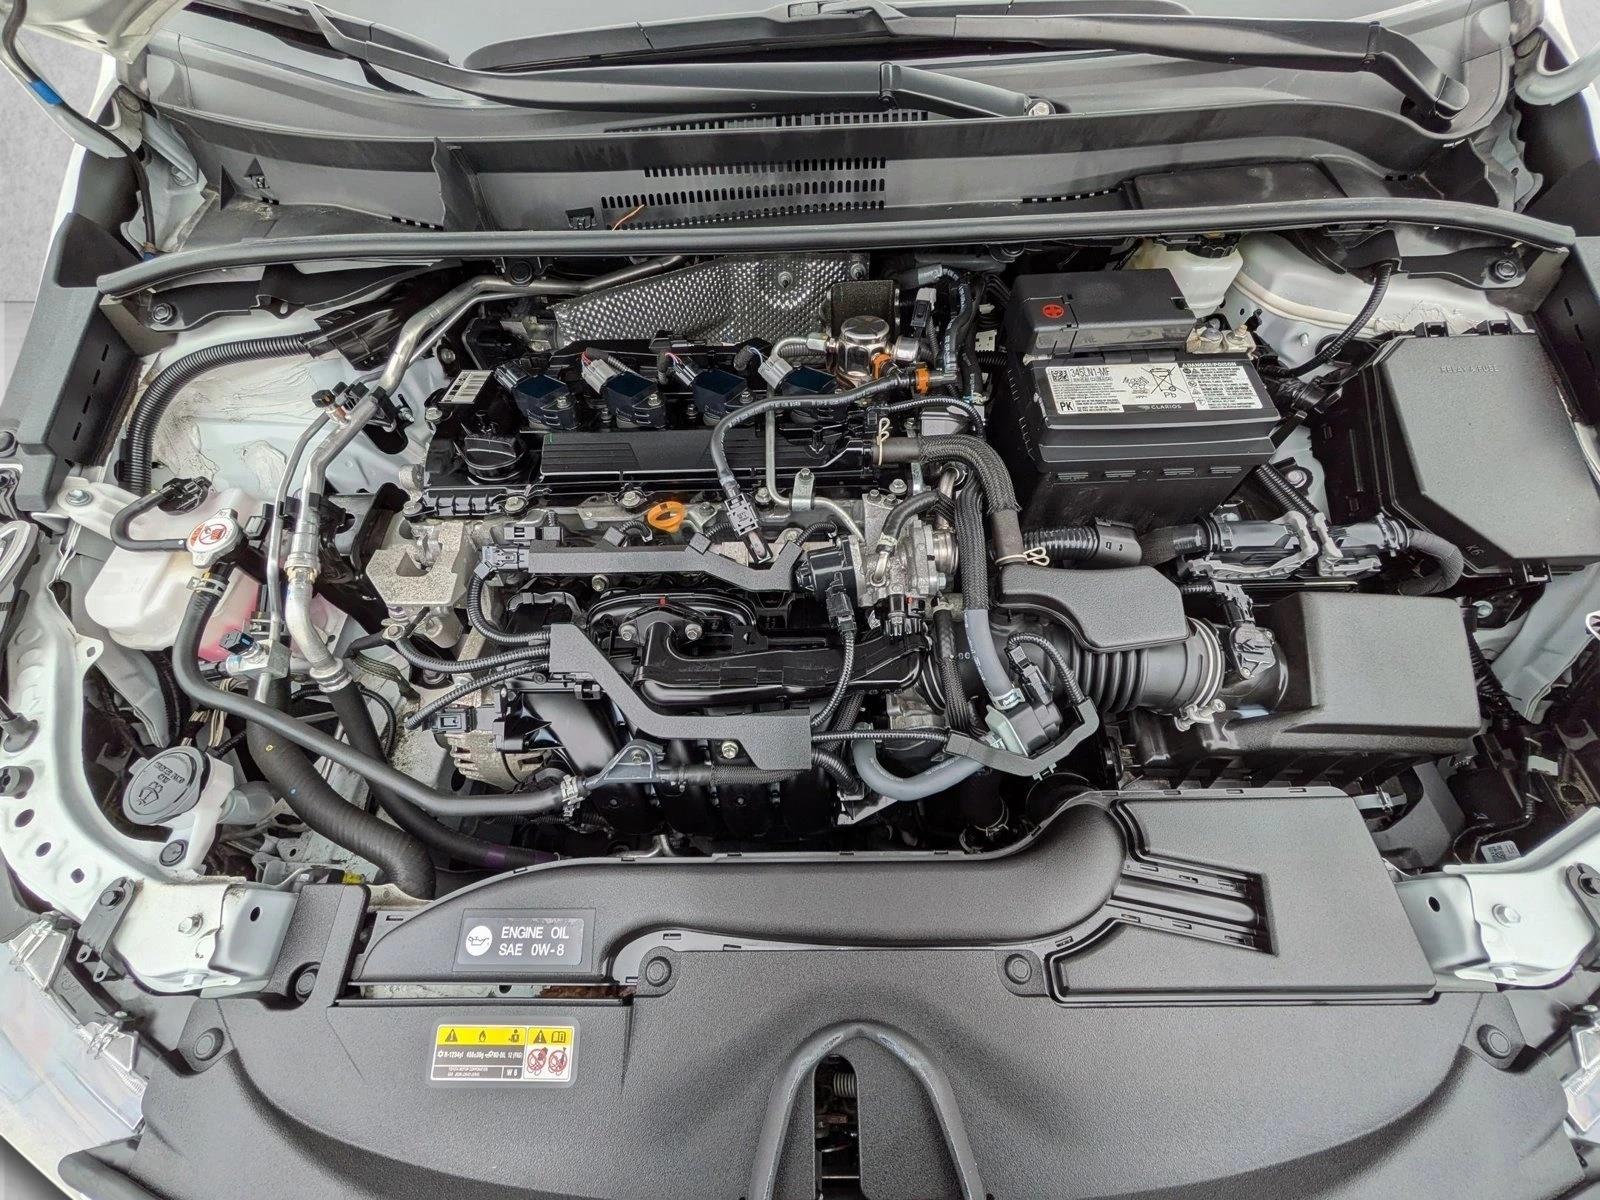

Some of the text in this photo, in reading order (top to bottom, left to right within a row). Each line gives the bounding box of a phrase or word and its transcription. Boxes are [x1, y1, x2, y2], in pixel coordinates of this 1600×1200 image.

[1070, 367, 1110, 377] 345LN1-MF
[1060, 401, 1073, 411] PK
[501, 926, 570, 939] ENGINE OIL
[498, 943, 565, 956] SAE 0W-8
